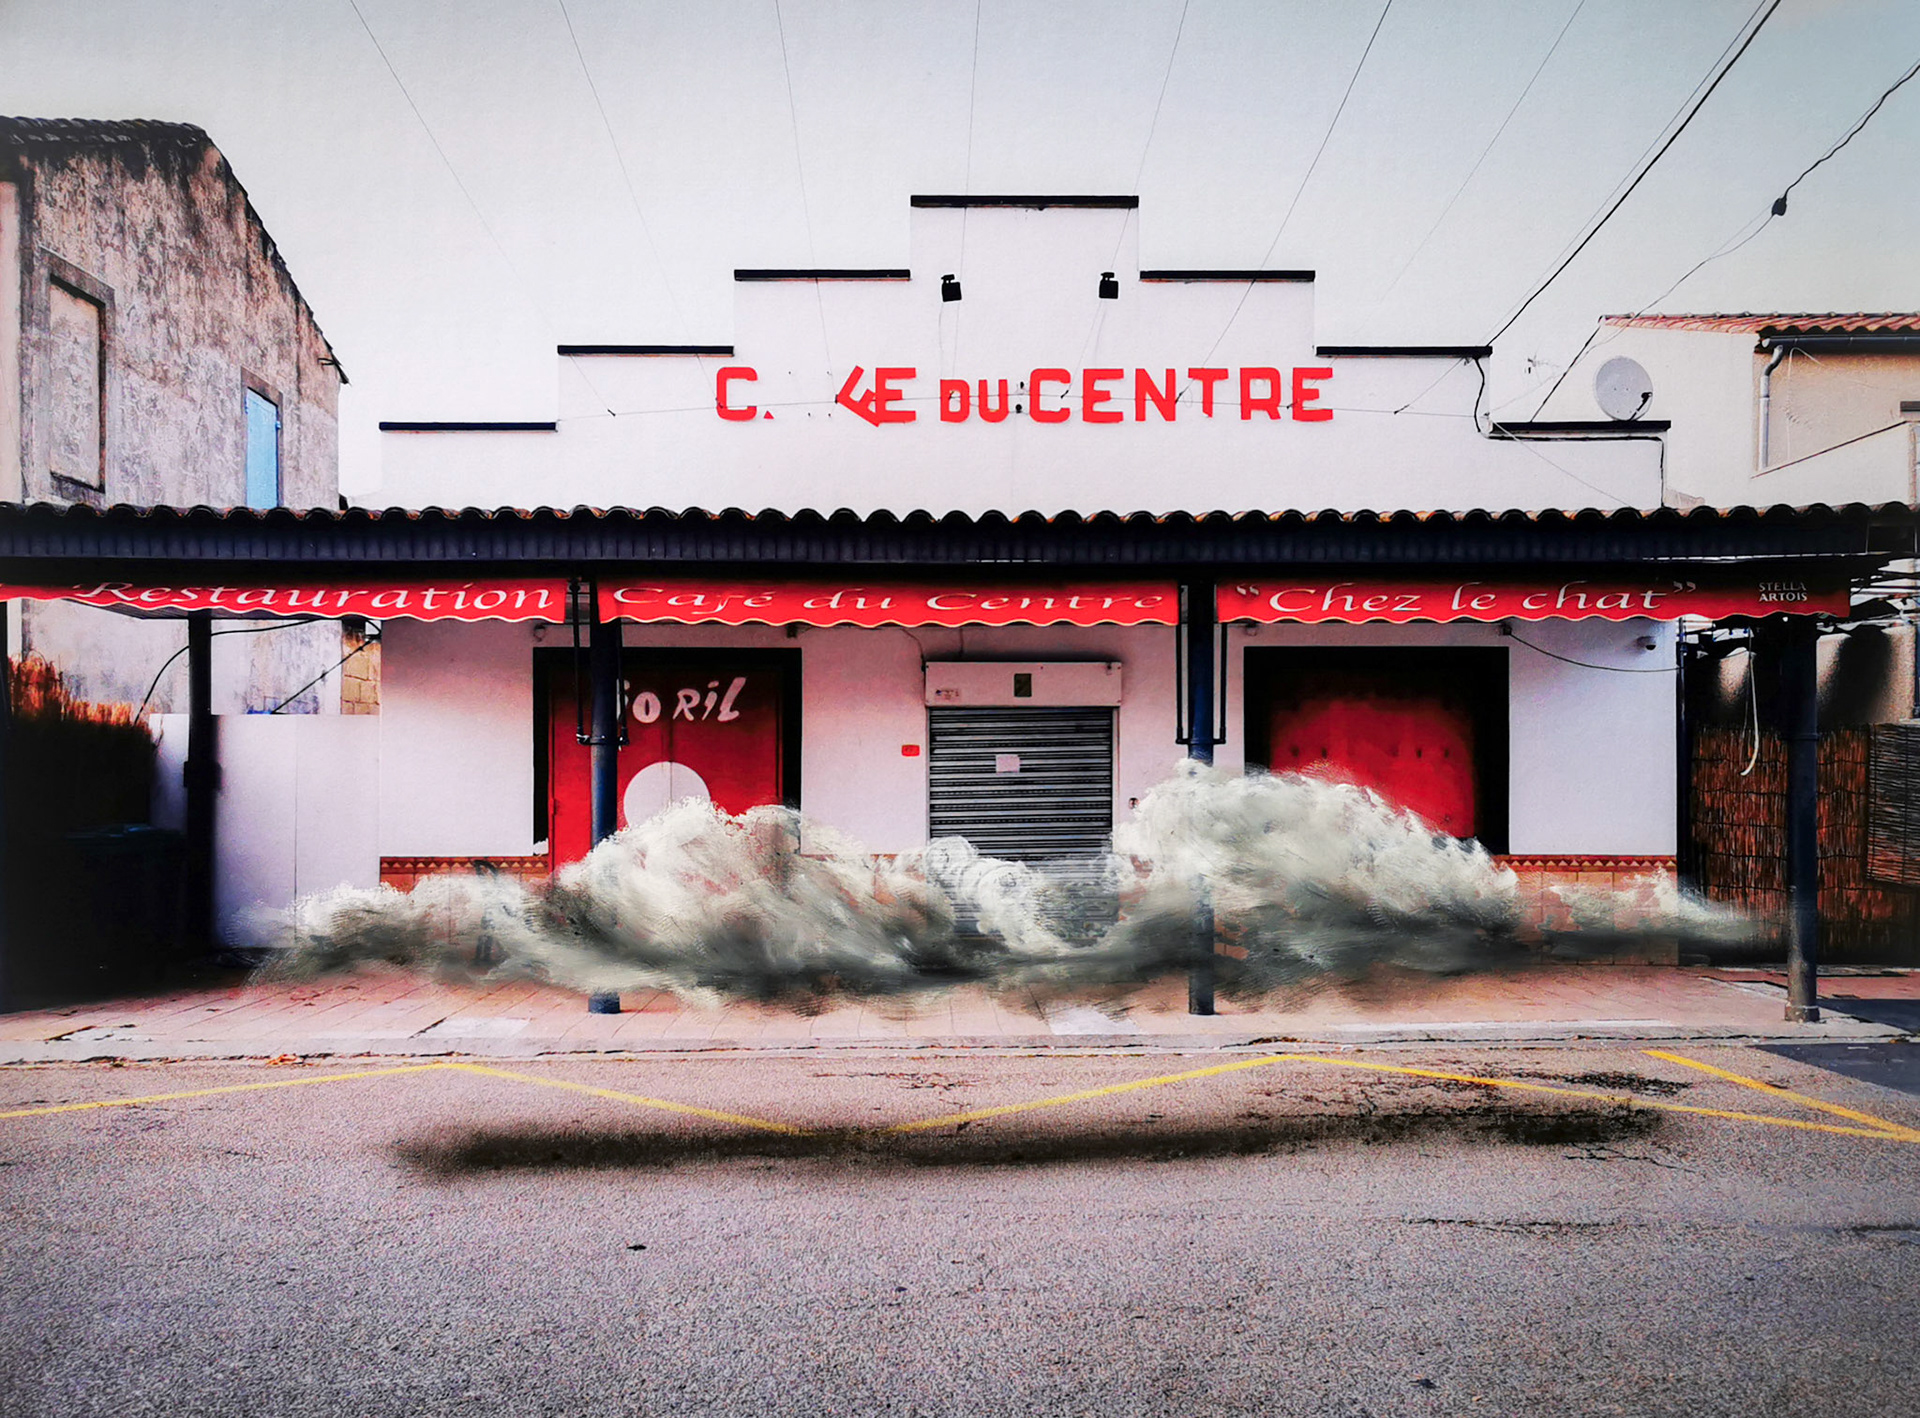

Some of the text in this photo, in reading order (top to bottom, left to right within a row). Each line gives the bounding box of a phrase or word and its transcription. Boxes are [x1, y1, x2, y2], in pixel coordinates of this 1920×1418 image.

[939, 378, 1009, 423] DU
[1029, 366, 1334, 423] CENTRE
[73, 582, 554, 610] Restauration
[1450, 581, 1497, 611] le
[1758, 581, 1807, 591] STELLA
[1758, 591, 1808, 602] ARTOIS
[613, 587, 1163, 615] Café du Centre
